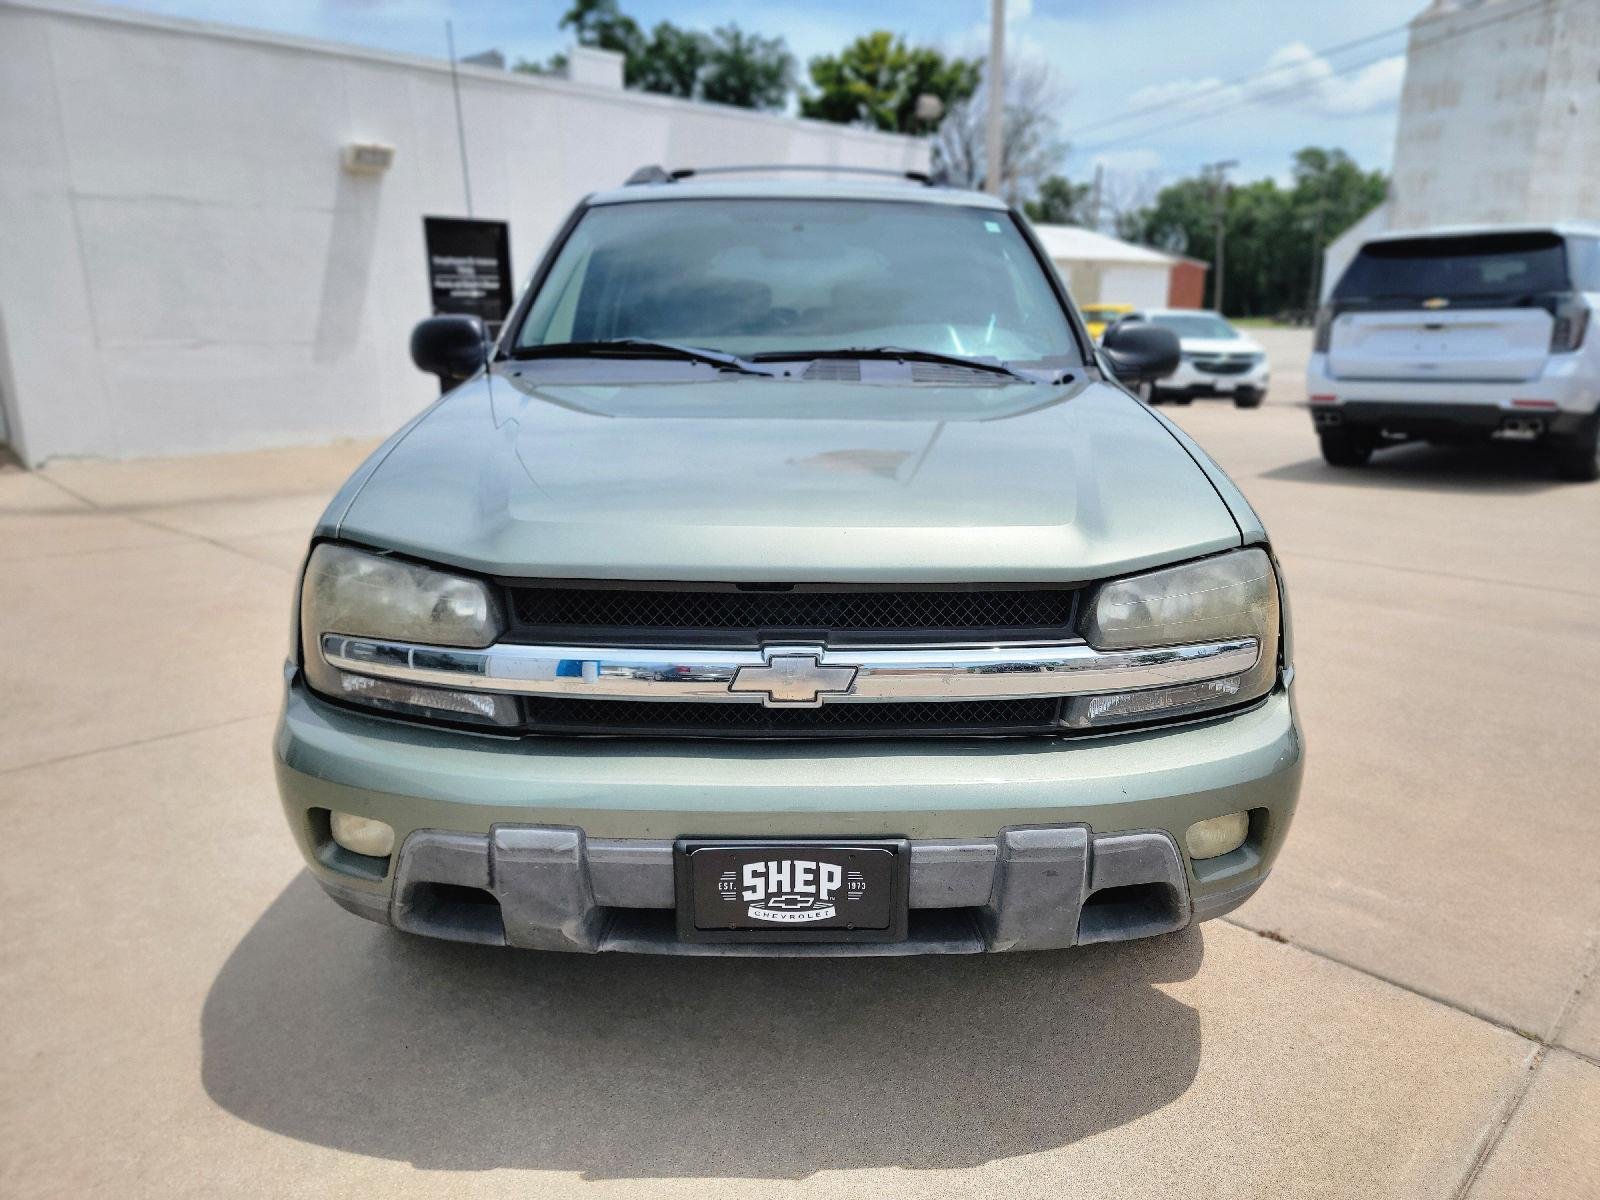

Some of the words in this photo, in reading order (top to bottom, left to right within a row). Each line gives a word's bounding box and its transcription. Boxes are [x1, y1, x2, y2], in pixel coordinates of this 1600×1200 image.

[742, 860, 842, 901] SHEP
[718, 882, 737, 890] EST.
[847, 882, 866, 890] 1973
[754, 910, 829, 920] CHEVROLET
